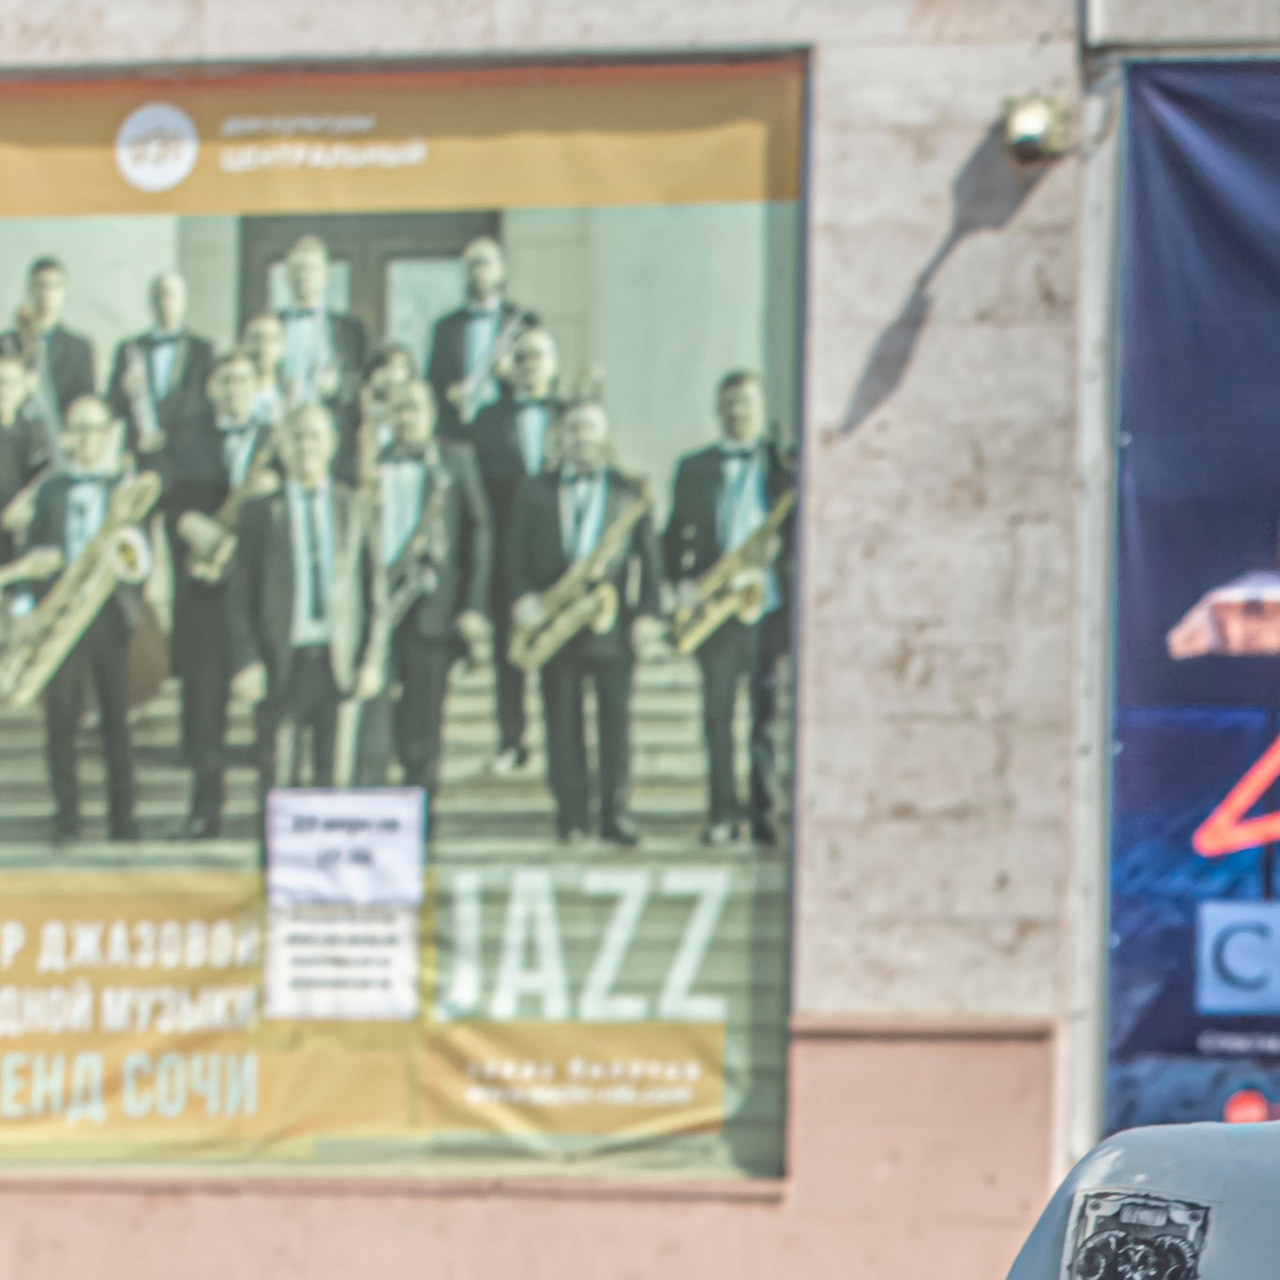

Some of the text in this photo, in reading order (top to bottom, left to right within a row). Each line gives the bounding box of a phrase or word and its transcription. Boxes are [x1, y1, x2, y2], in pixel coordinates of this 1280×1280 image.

[432, 867, 732, 1022] JAZZ
[1209, 919, 1272, 992] С
[101, 985, 258, 1036] МУЗЫКИ
[121, 1050, 258, 1117] СОЧИ
